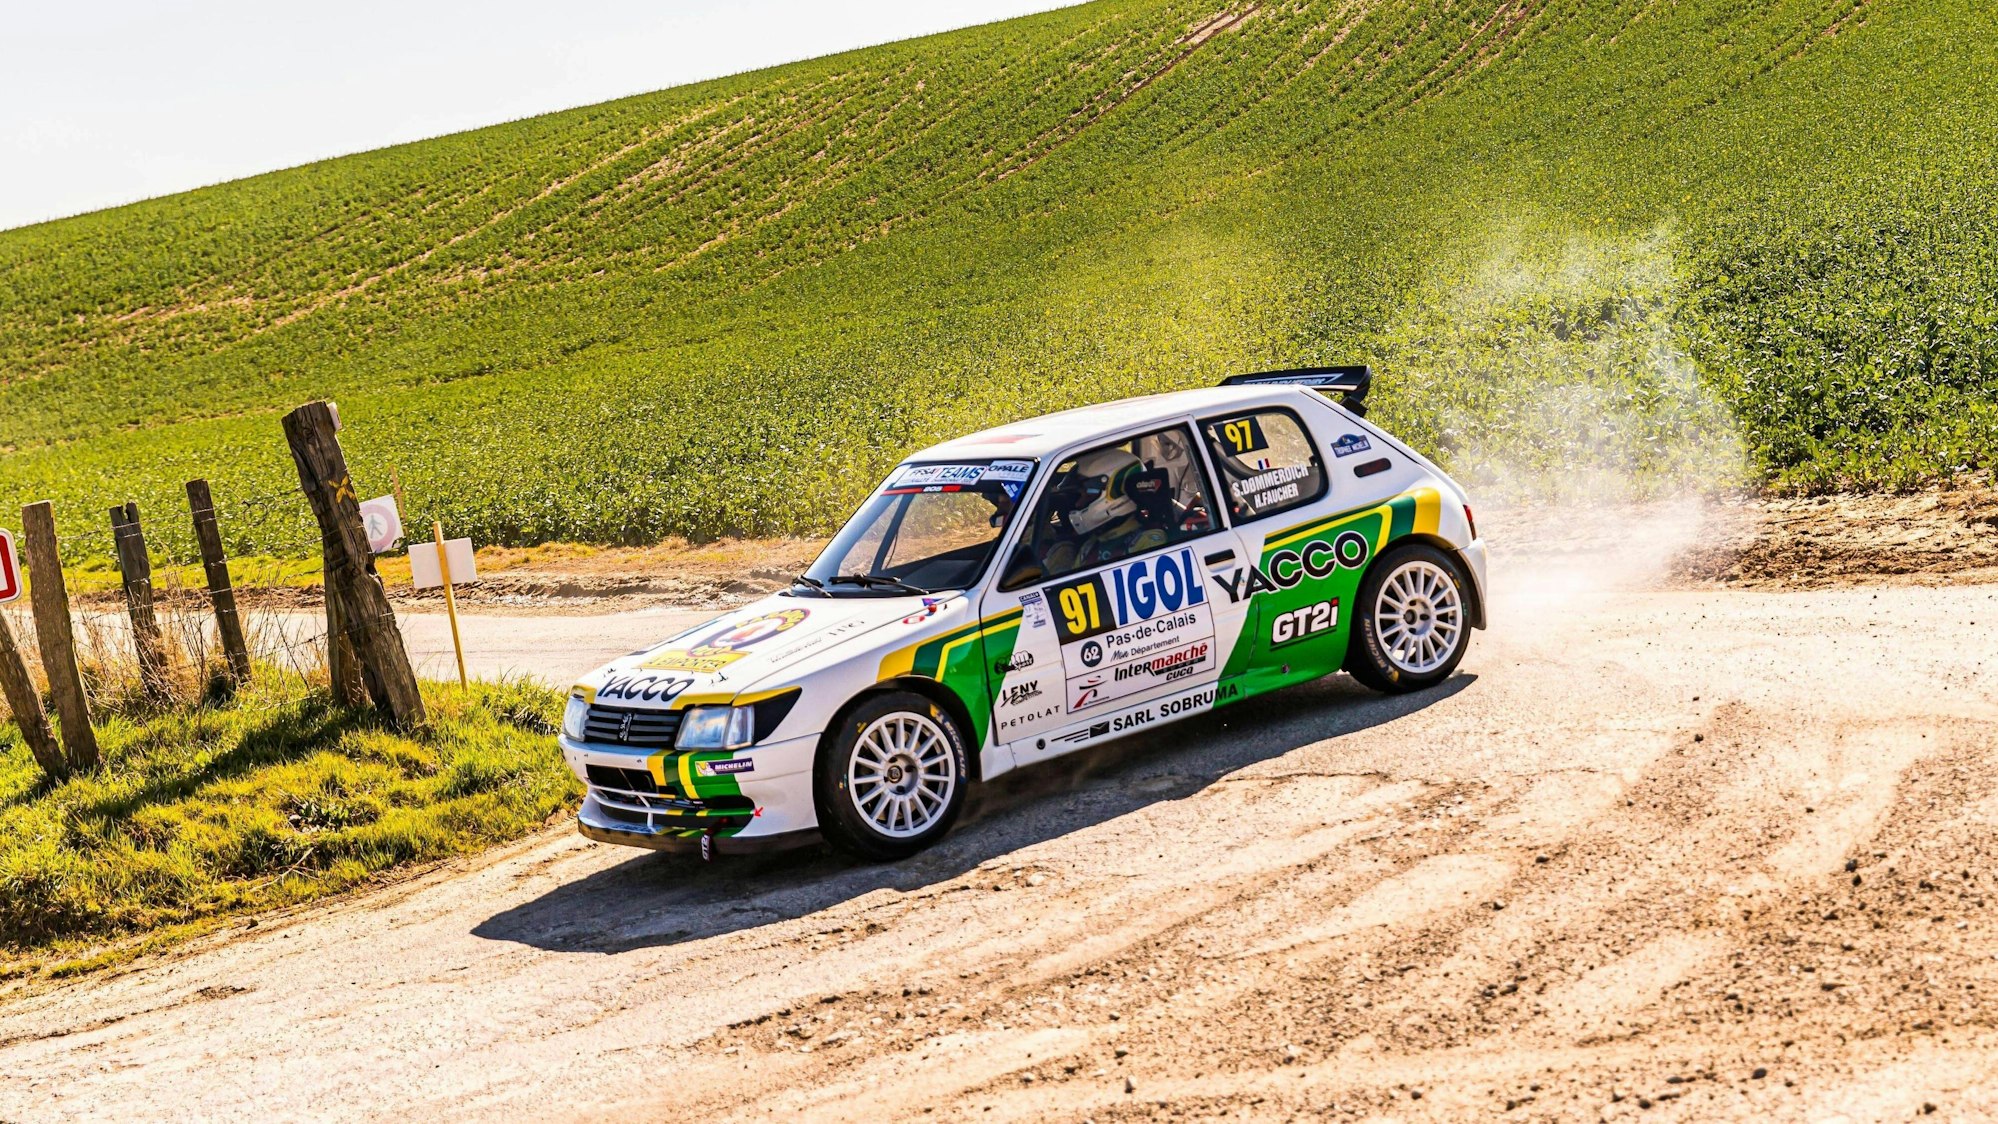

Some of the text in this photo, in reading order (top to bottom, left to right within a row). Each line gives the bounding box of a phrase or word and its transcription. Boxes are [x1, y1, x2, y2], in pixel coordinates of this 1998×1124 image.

[1224, 420, 1253, 452] 97
[940, 466, 985, 479] TEAMS
[988, 465, 1030, 474] OPALE
[1211, 530, 1369, 604] YACCO
[1059, 549, 1204, 635] 97 IGOL
[1272, 597, 1339, 644] GT2i
[1083, 645, 1100, 662] 62
[1131, 635, 1180, 657] Département
[597, 676, 695, 702] YACCO
[1002, 680, 1038, 702] LENY
[1001, 705, 1060, 730] PETOLAT
[1113, 684, 1238, 731] SARL SOBRUMA
[715, 760, 753, 771] MICHELIN
